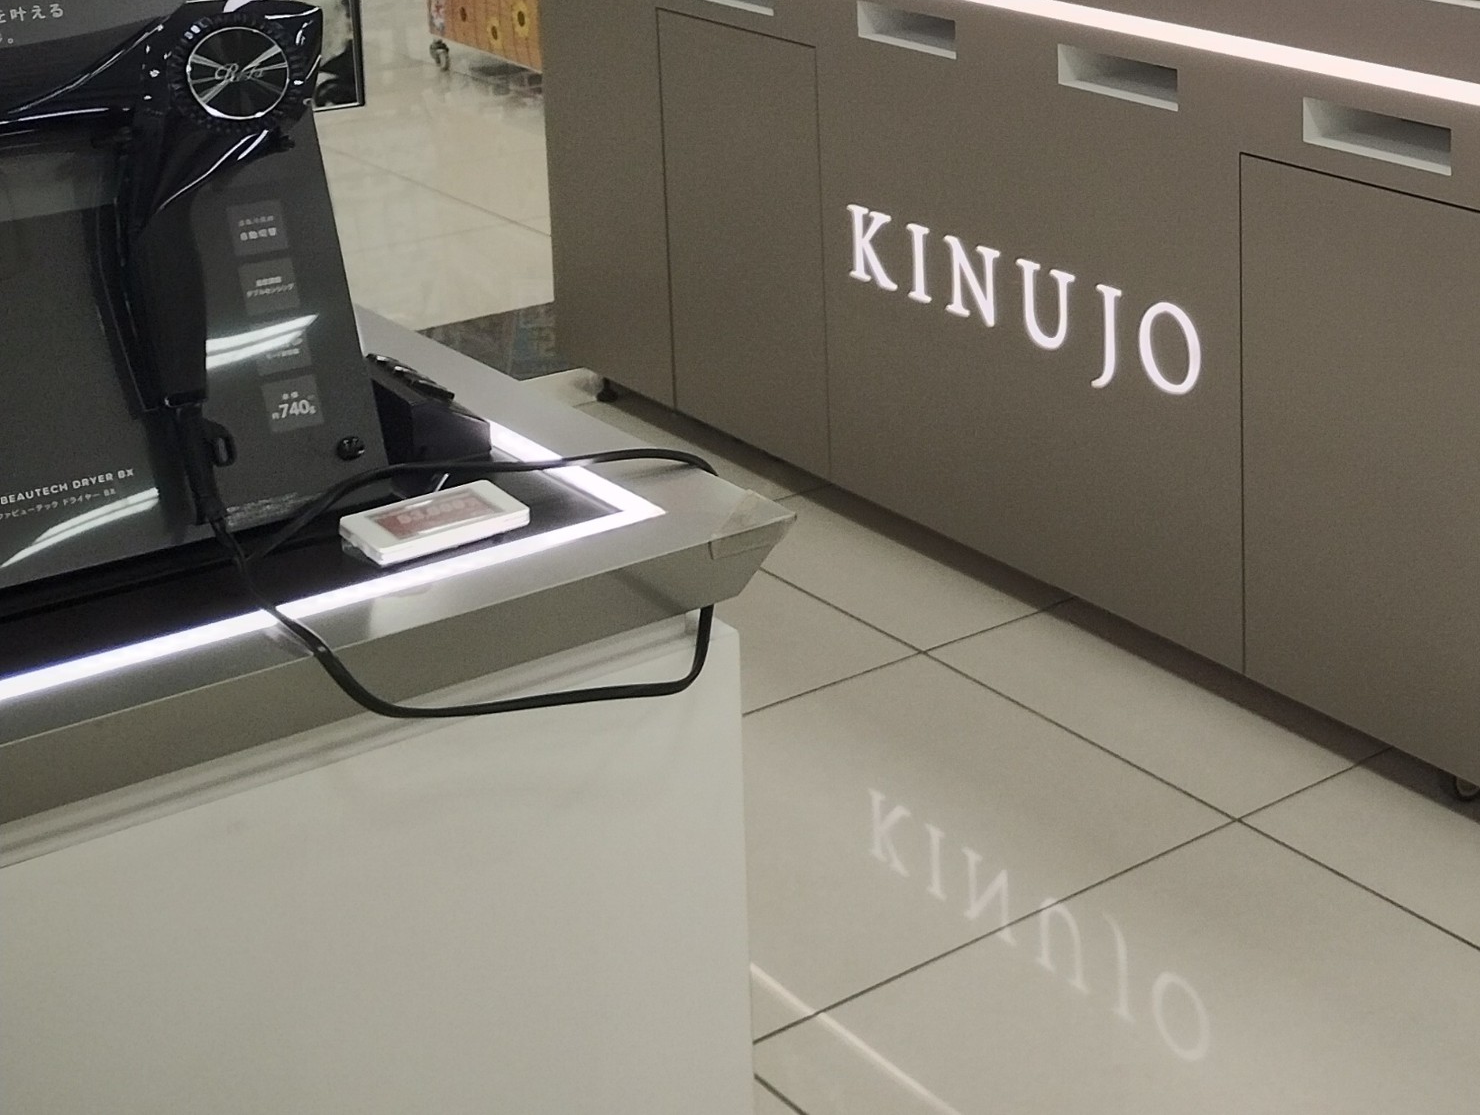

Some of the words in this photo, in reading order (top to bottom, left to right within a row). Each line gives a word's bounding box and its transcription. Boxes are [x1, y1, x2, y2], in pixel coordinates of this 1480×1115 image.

[846, 203, 1201, 395] KINUJO
[0, 482, 69, 506] BEAUTECH
[72, 472, 114, 490] DRYER
[117, 468, 135, 480] BX
[62, 491, 100, 507] ドライヤー
